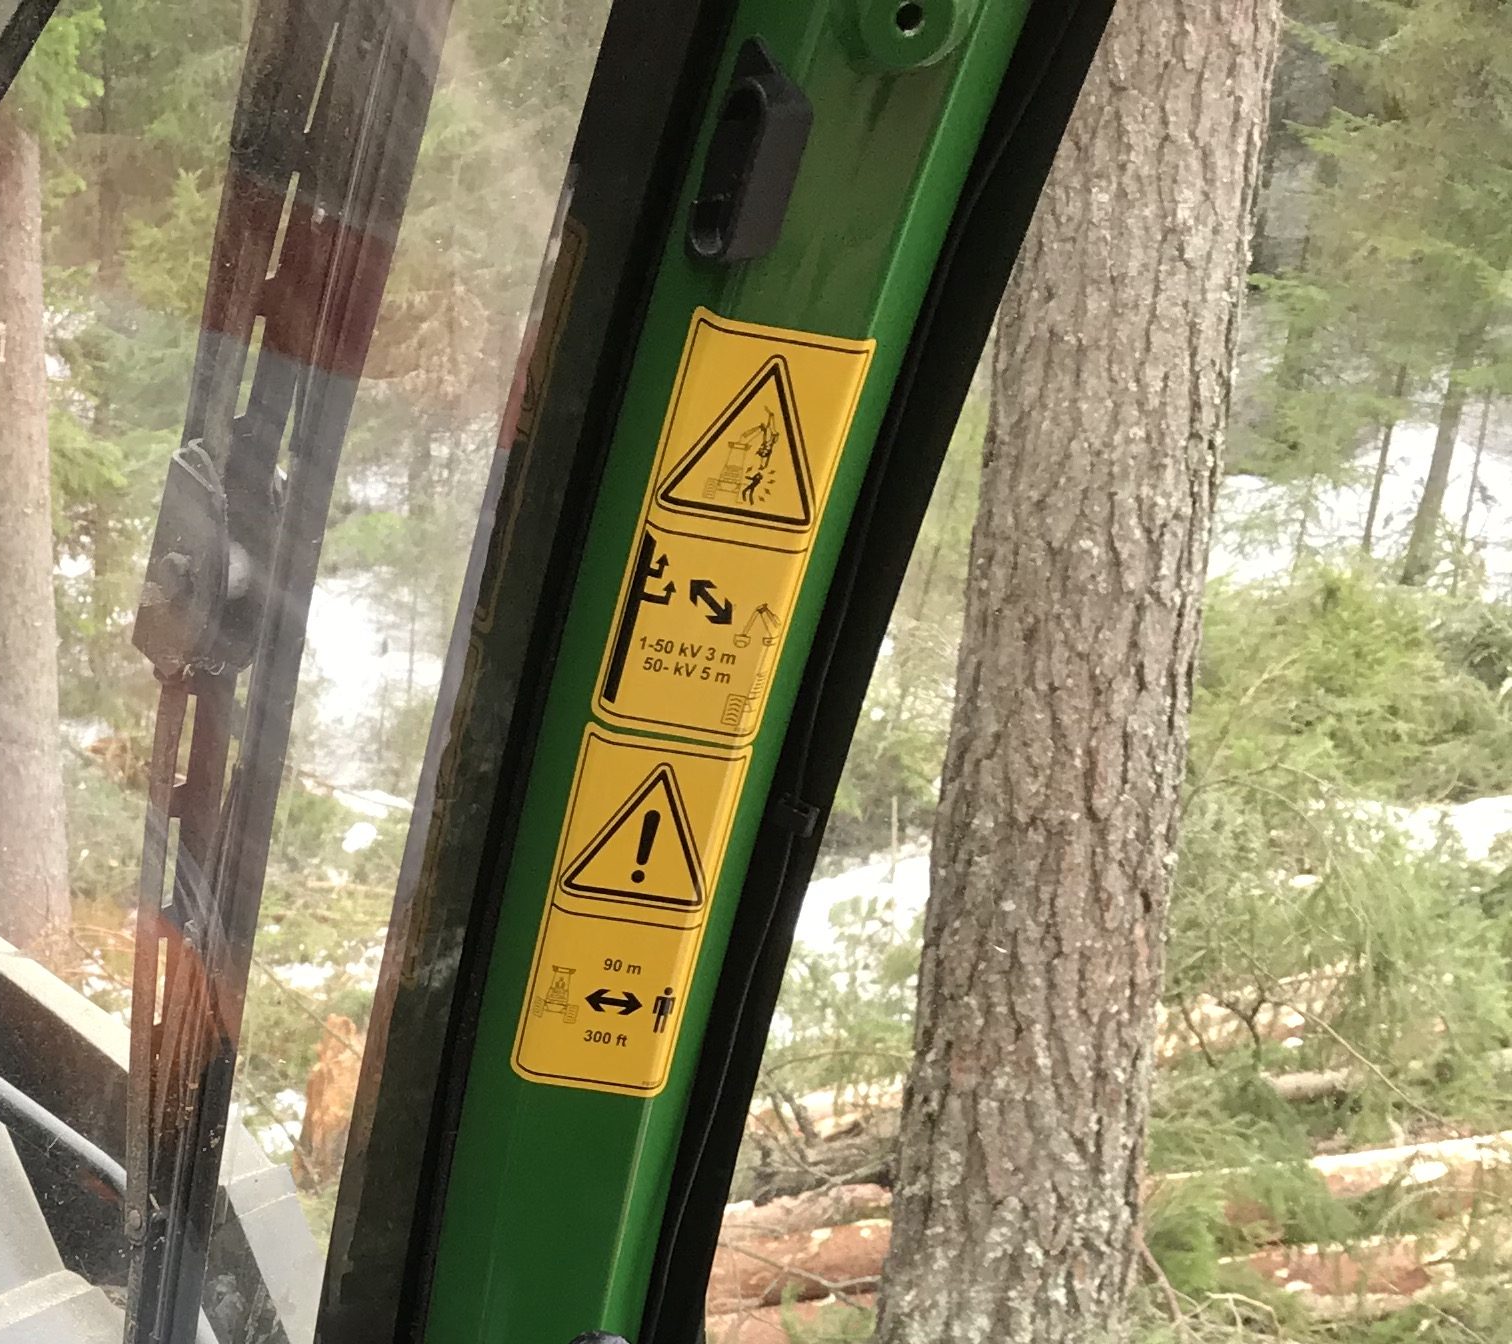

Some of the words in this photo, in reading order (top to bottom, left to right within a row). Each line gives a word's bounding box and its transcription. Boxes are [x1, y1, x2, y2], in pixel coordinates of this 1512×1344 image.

[639, 636, 675, 654] 1-50
[678, 642, 702, 658] kV
[705, 647, 716, 661] 3
[720, 652, 737, 665] m
[642, 656, 669, 673] 50-
[673, 661, 697, 677] kV
[700, 666, 711, 681] 5
[714, 671, 731, 684] m
[603, 958, 622, 972] 90
[626, 963, 642, 975] m
[583, 1029, 612, 1044] 300
[616, 1033, 628, 1047] ft
